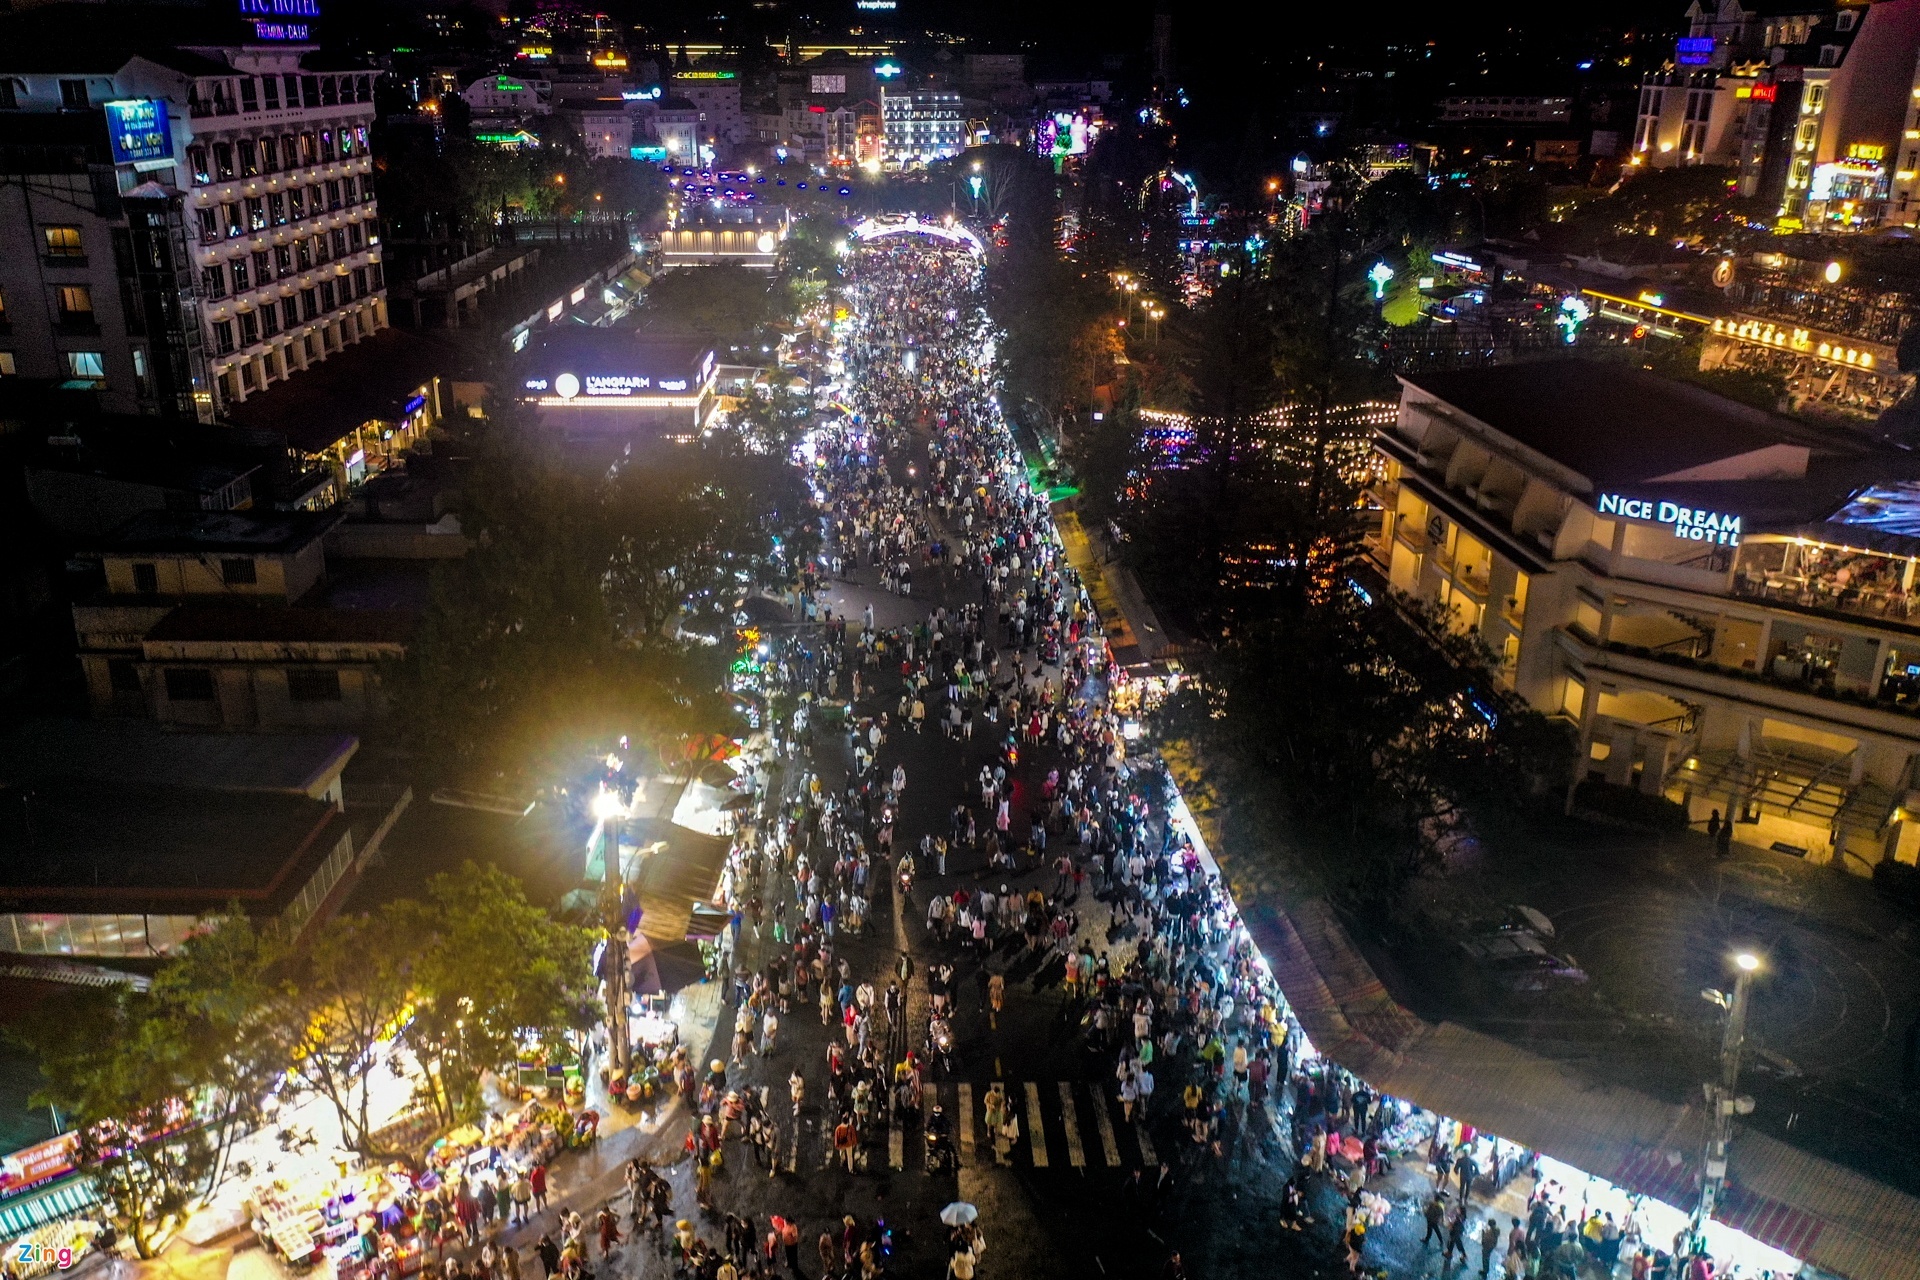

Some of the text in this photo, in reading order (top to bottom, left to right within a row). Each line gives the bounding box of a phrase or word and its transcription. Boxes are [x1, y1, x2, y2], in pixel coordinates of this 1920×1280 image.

[857, 0, 897, 10] vinaphone
[586, 376, 650, 388] L'ANGFARM
[1598, 493, 1741, 534] NICE DREAM
[1675, 524, 1740, 547] HOTEL
